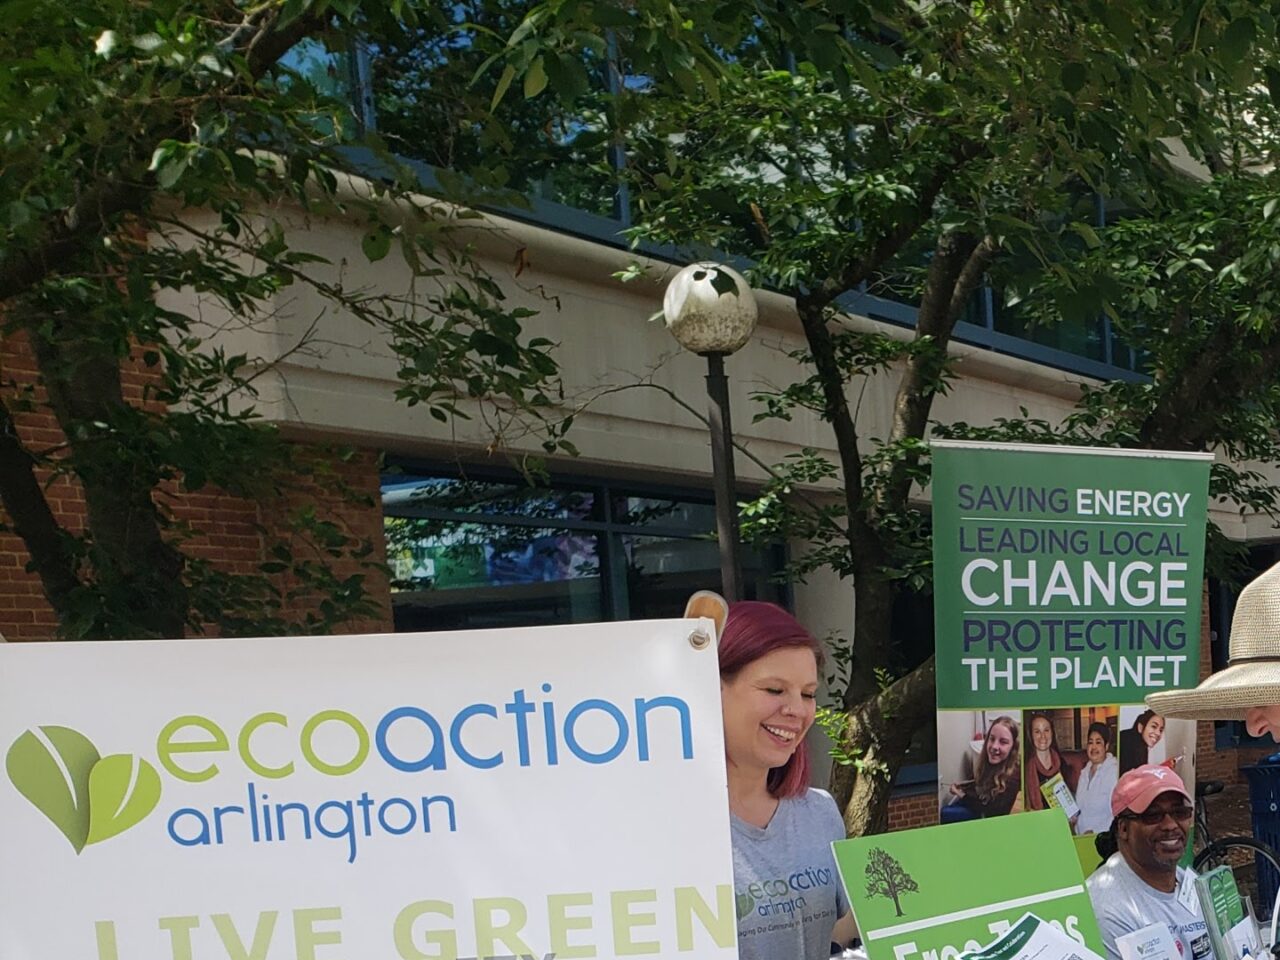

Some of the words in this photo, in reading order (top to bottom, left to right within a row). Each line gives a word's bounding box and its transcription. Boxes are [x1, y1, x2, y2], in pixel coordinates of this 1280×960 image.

[958, 484, 1069, 514] SAVING
[1076, 488, 1191, 518] ENERGY
[959, 526, 1089, 556] LEADING
[1099, 530, 1189, 557] LOCAL
[961, 558, 1188, 607] CHANGE
[962, 618, 1186, 653] PROTECTING
[962, 657, 1038, 691] THE
[1050, 655, 1187, 689] PLANET
[157, 683, 694, 783] ecoaction
[167, 782, 456, 863] arlington
